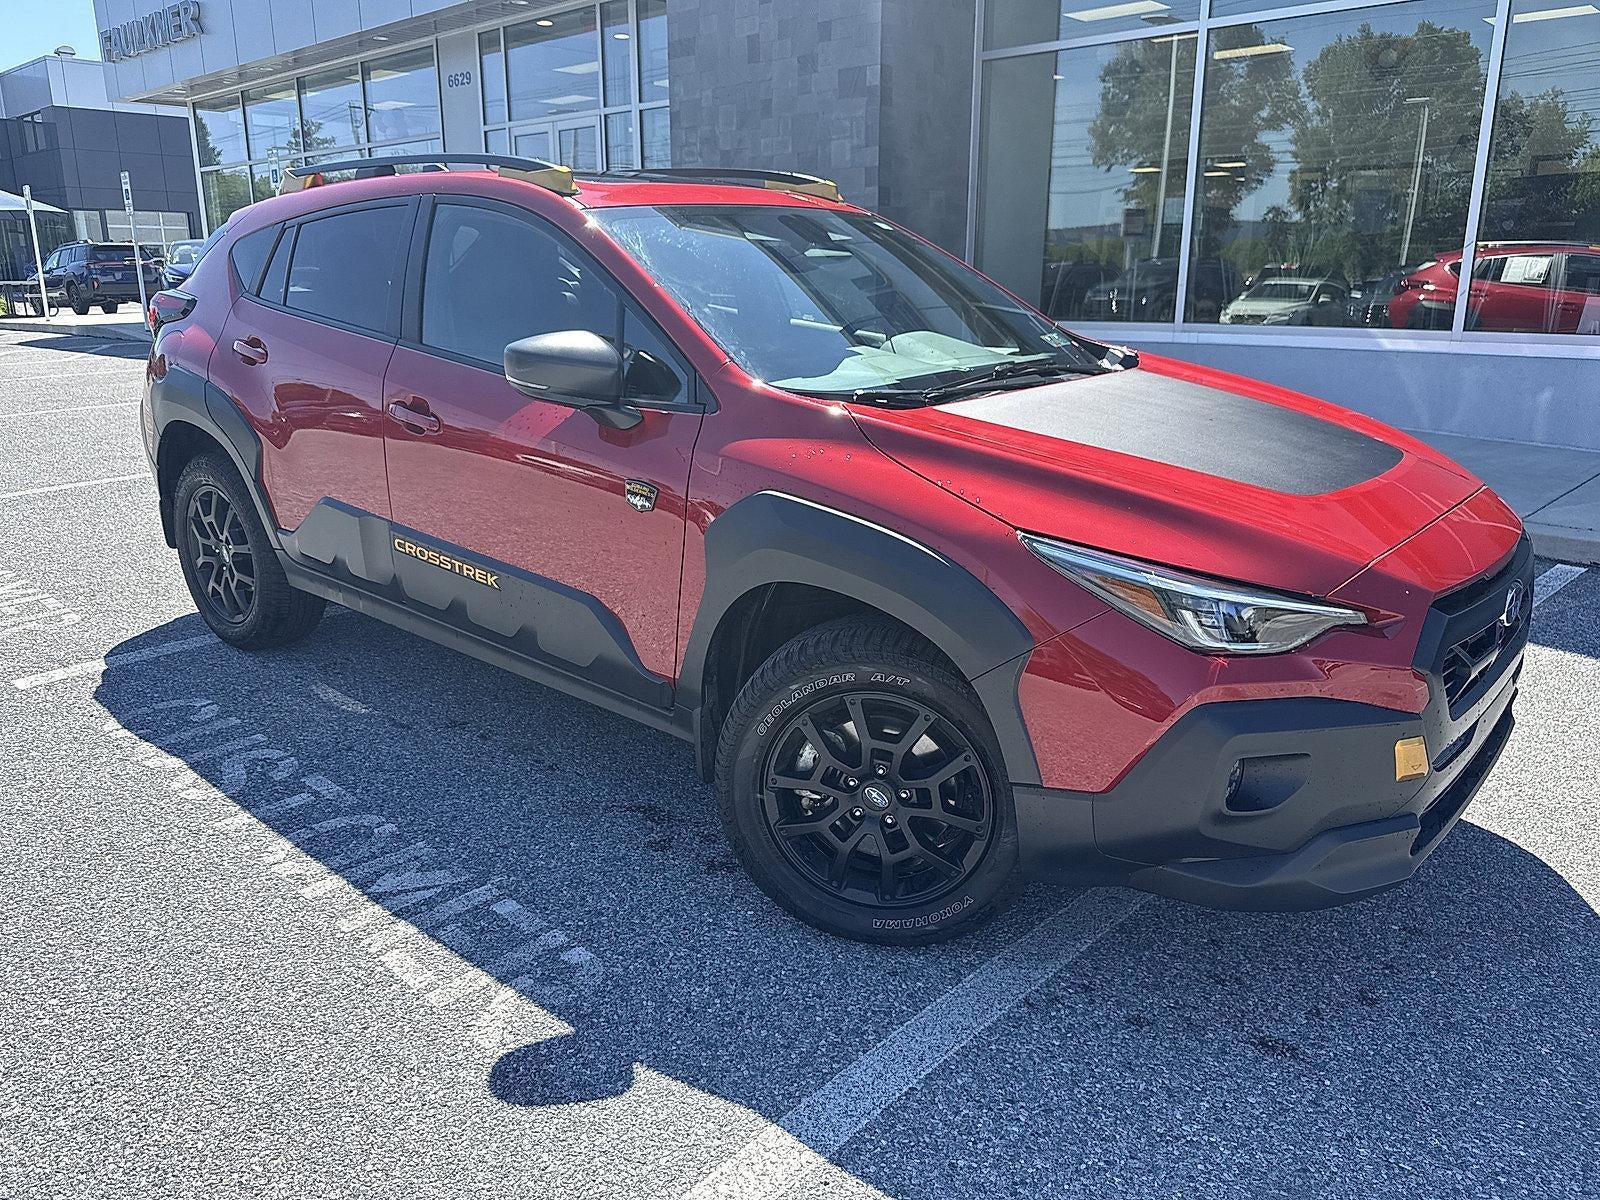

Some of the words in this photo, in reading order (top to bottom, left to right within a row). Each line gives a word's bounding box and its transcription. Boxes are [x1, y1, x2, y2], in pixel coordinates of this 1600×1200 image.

[100, 0, 204, 62] FAULKNER
[448, 71, 471, 88] 6629
[394, 538, 501, 590] CROSSTREK
[756, 672, 856, 737] GEOLANDAR
[870, 672, 911, 686] A/T
[872, 895, 975, 929] YOKOHAMA
